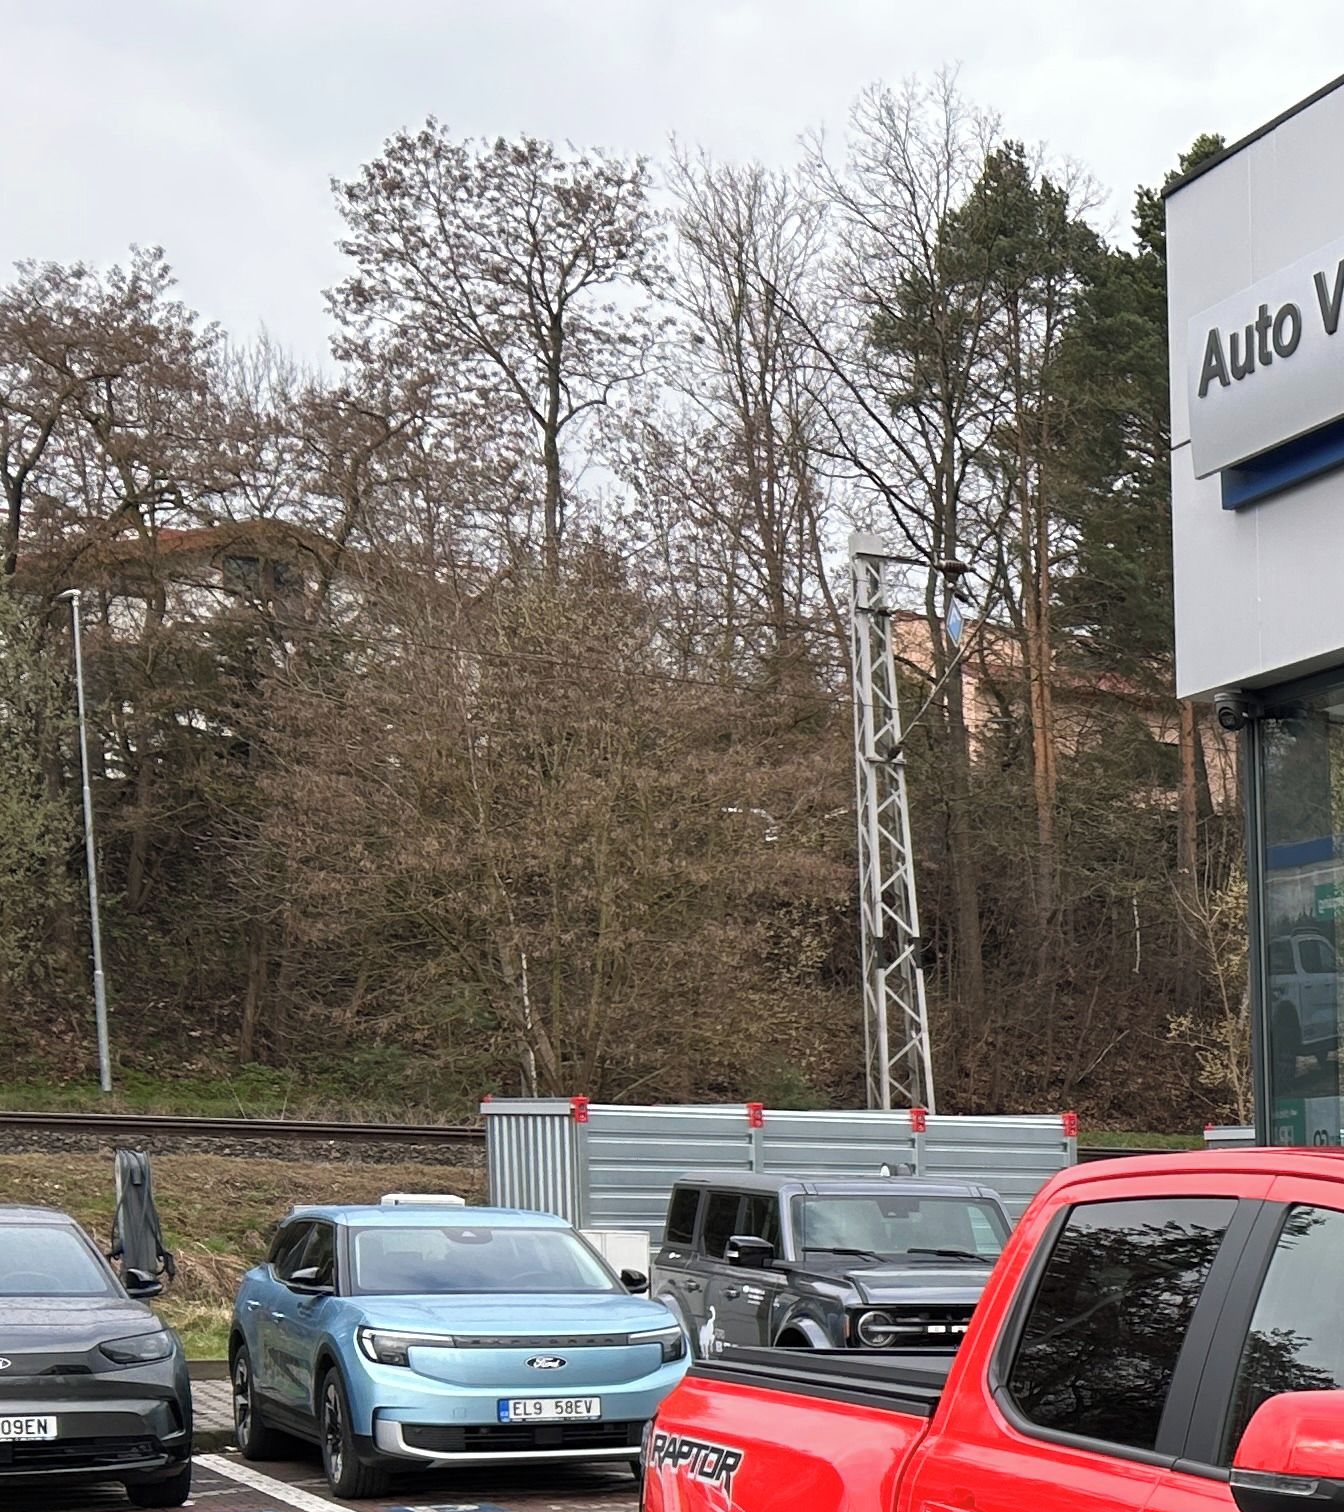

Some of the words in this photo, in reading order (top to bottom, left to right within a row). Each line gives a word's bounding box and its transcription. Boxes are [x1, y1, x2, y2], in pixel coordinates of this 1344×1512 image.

[1197, 300, 1302, 398] Auto
[532, 1355, 561, 1370] Ford
[512, 1400, 543, 1416] EL9
[554, 1399, 593, 1415] 58EV
[1, 1418, 48, 1436] 09EN
[650, 1432, 744, 1494] RAPTOR
